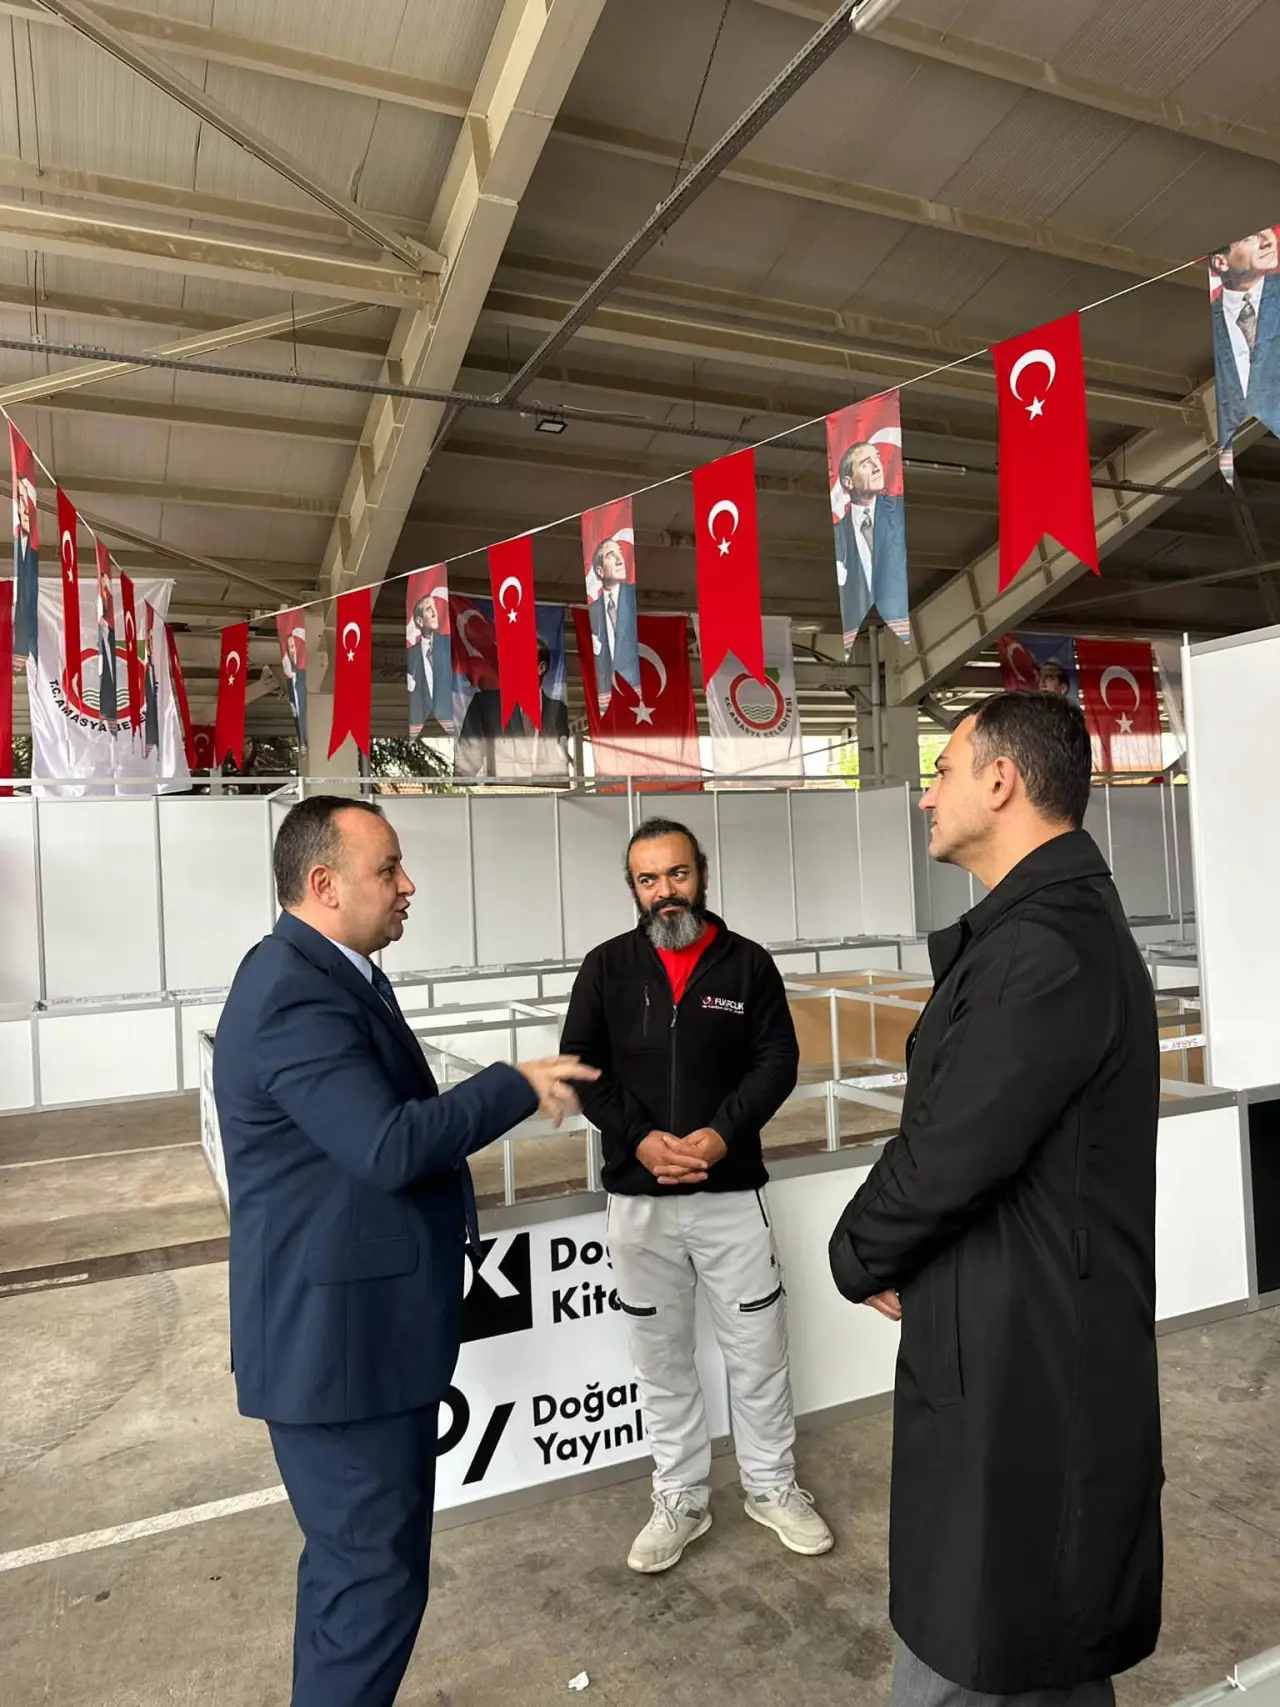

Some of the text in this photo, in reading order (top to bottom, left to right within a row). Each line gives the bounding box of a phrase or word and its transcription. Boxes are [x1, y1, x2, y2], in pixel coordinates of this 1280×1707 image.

[55, 699, 108, 733] AMASYA
[729, 711, 761, 738] AMASYA
[550, 1237, 613, 1272] Do
[533, 1408, 648, 1465] Yayınl
